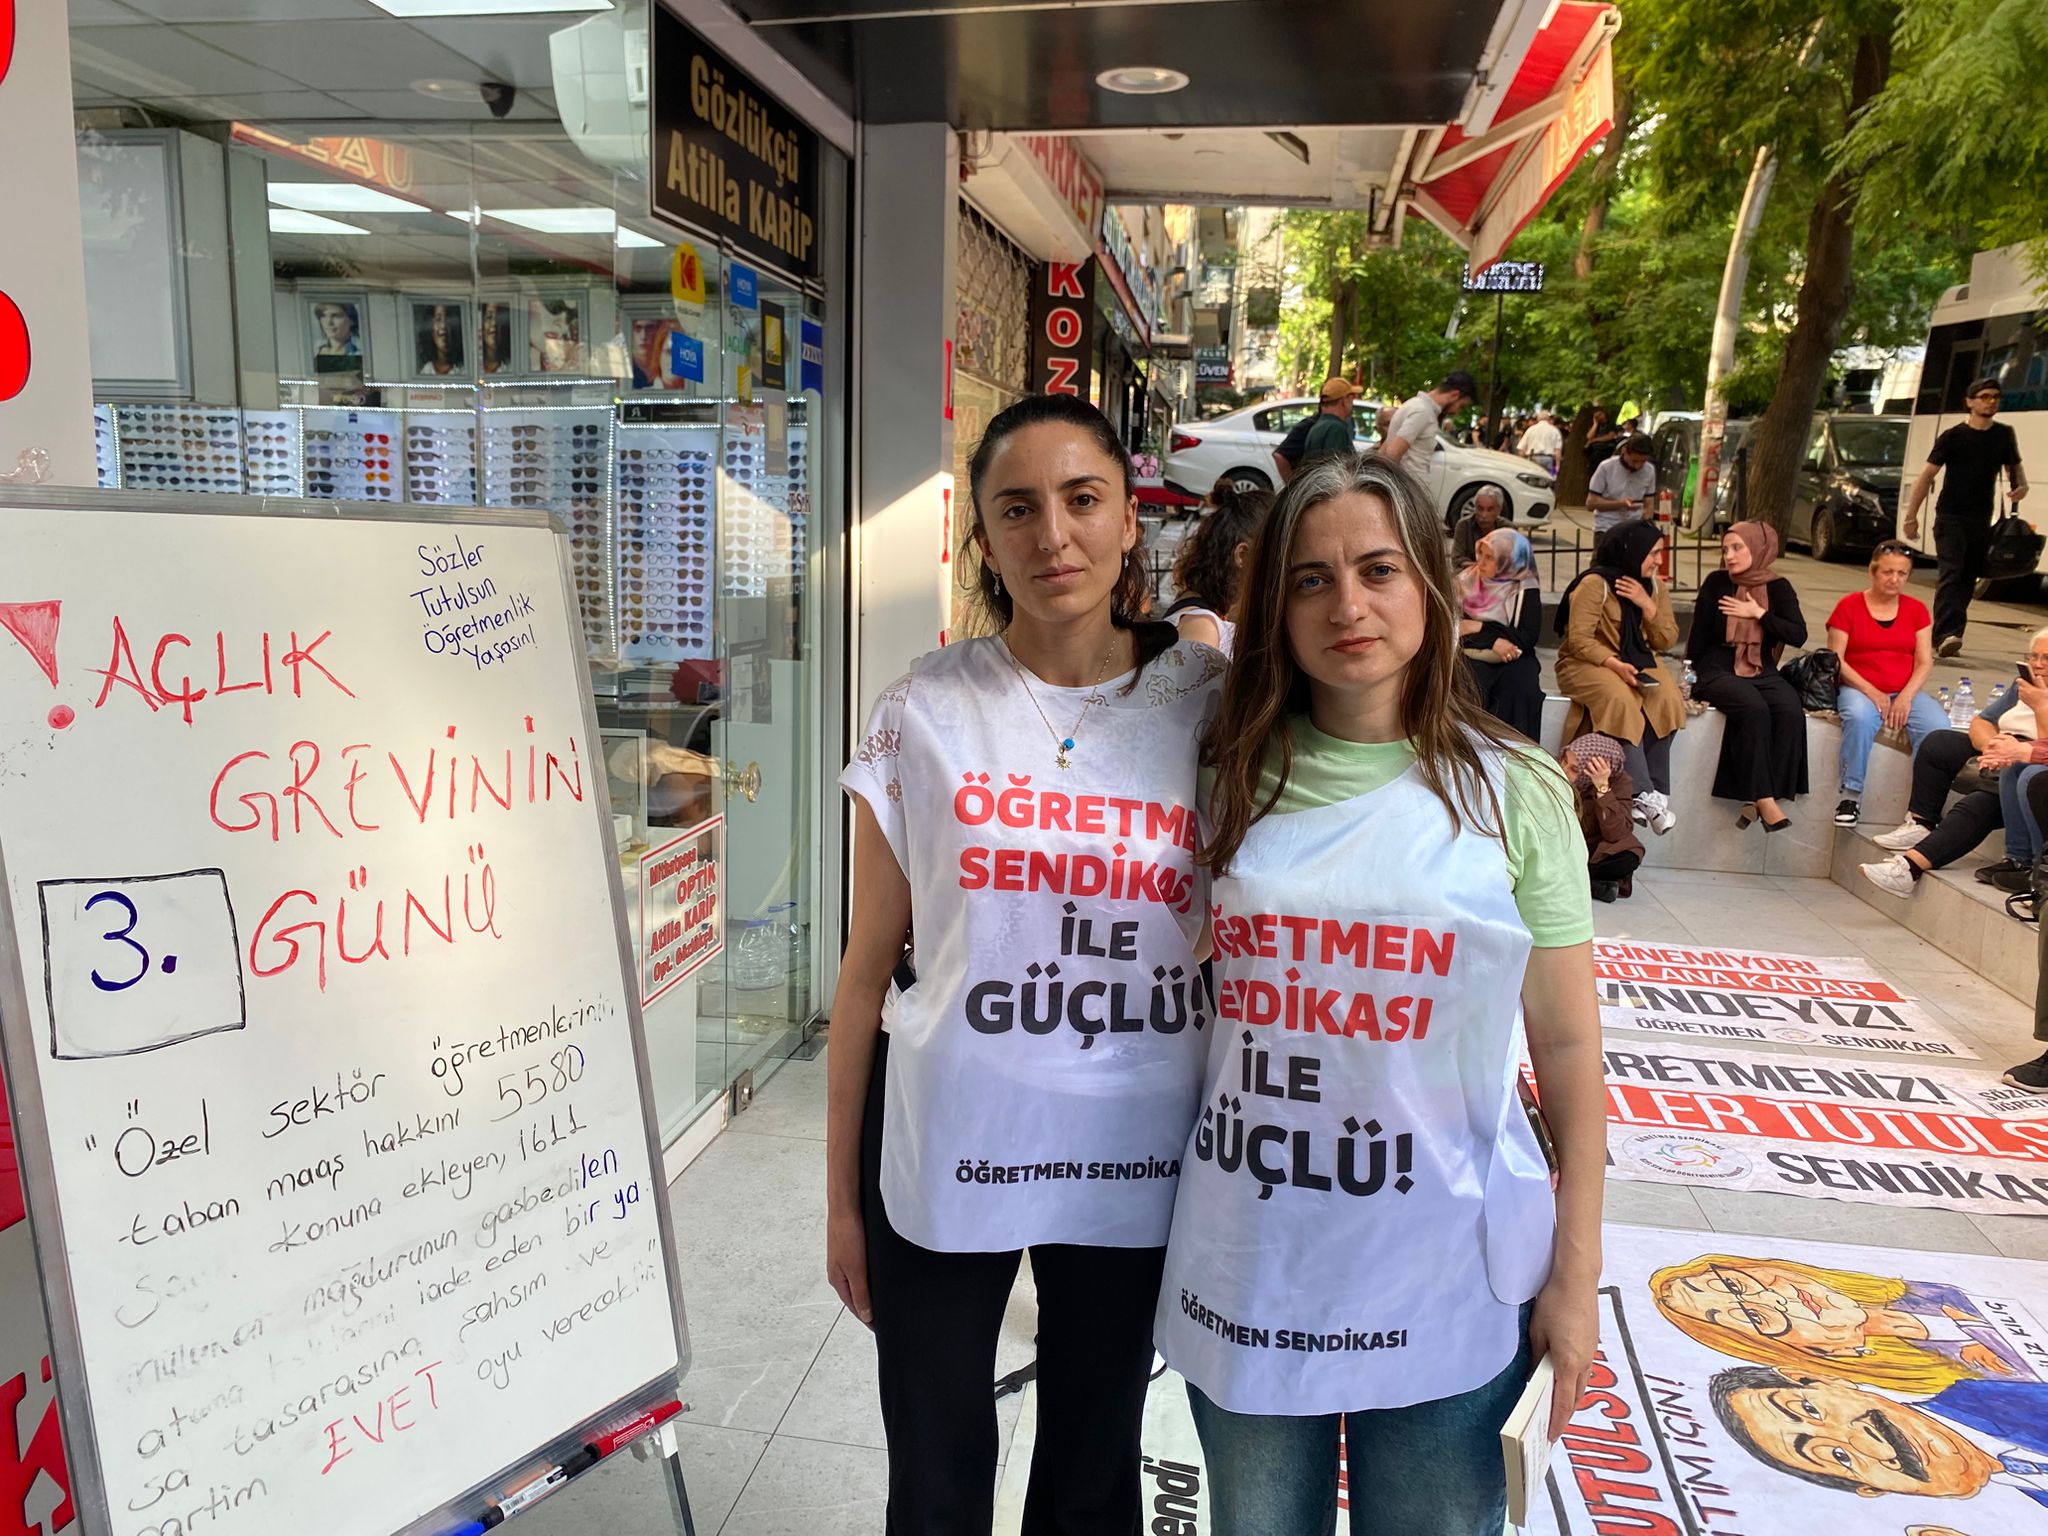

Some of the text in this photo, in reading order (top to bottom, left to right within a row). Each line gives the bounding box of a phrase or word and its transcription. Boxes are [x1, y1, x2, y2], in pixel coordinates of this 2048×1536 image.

[690, 54, 799, 188] Gözlükçü
[666, 129, 813, 261] Atilla KARİP
[1197, 364, 1229, 376] ÜVEN
[418, 534, 485, 577] Sözler
[410, 577, 497, 617] Tutulsun
[423, 592, 536, 656] Öğretmenlik
[82, 614, 358, 727] AÇLIK
[462, 623, 538, 671] Yaşasın!
[208, 715, 584, 842] GREVİNİN
[676, 859, 717, 905] OPTİK
[84, 842, 503, 994] 3. GÜNÜ
[650, 891, 717, 957] Atilla KARİP
[1060, 900, 1140, 961] İLE
[1212, 903, 1456, 977] ĞRETMEN
[965, 961, 1206, 1050] GÜÇLÜ!
[1743, 974, 1877, 999] KADAR
[1241, 1029, 1321, 1104] İLE
[1634, 1017, 1956, 1055] ÖĞRETMEN SENDİKASI
[262, 1067, 386, 1139] sektör
[1605, 1085, 1762, 1134] LER
[118, 1044, 585, 1246] taban maaş hakkını 5580
[402, 1151, 506, 1201] ekleyen,
[955, 1155, 1181, 1185] ÖĞRETMEN SENDİKA
[1195, 1092, 1415, 1201] GÜÇLÜ!
[474, 1149, 618, 1249] gasbedilen
[417, 1265, 472, 1305] iade
[485, 1234, 543, 1271] eden
[565, 1199, 601, 1237] bir
[1181, 1288, 1408, 1352] ÖĞRETMEN SENDİKASI
[137, 1478, 268, 1536] artim
[320, 1361, 443, 1476] EVET
[476, 1340, 522, 1390] oyu
[128, 1468, 190, 1512] sa
